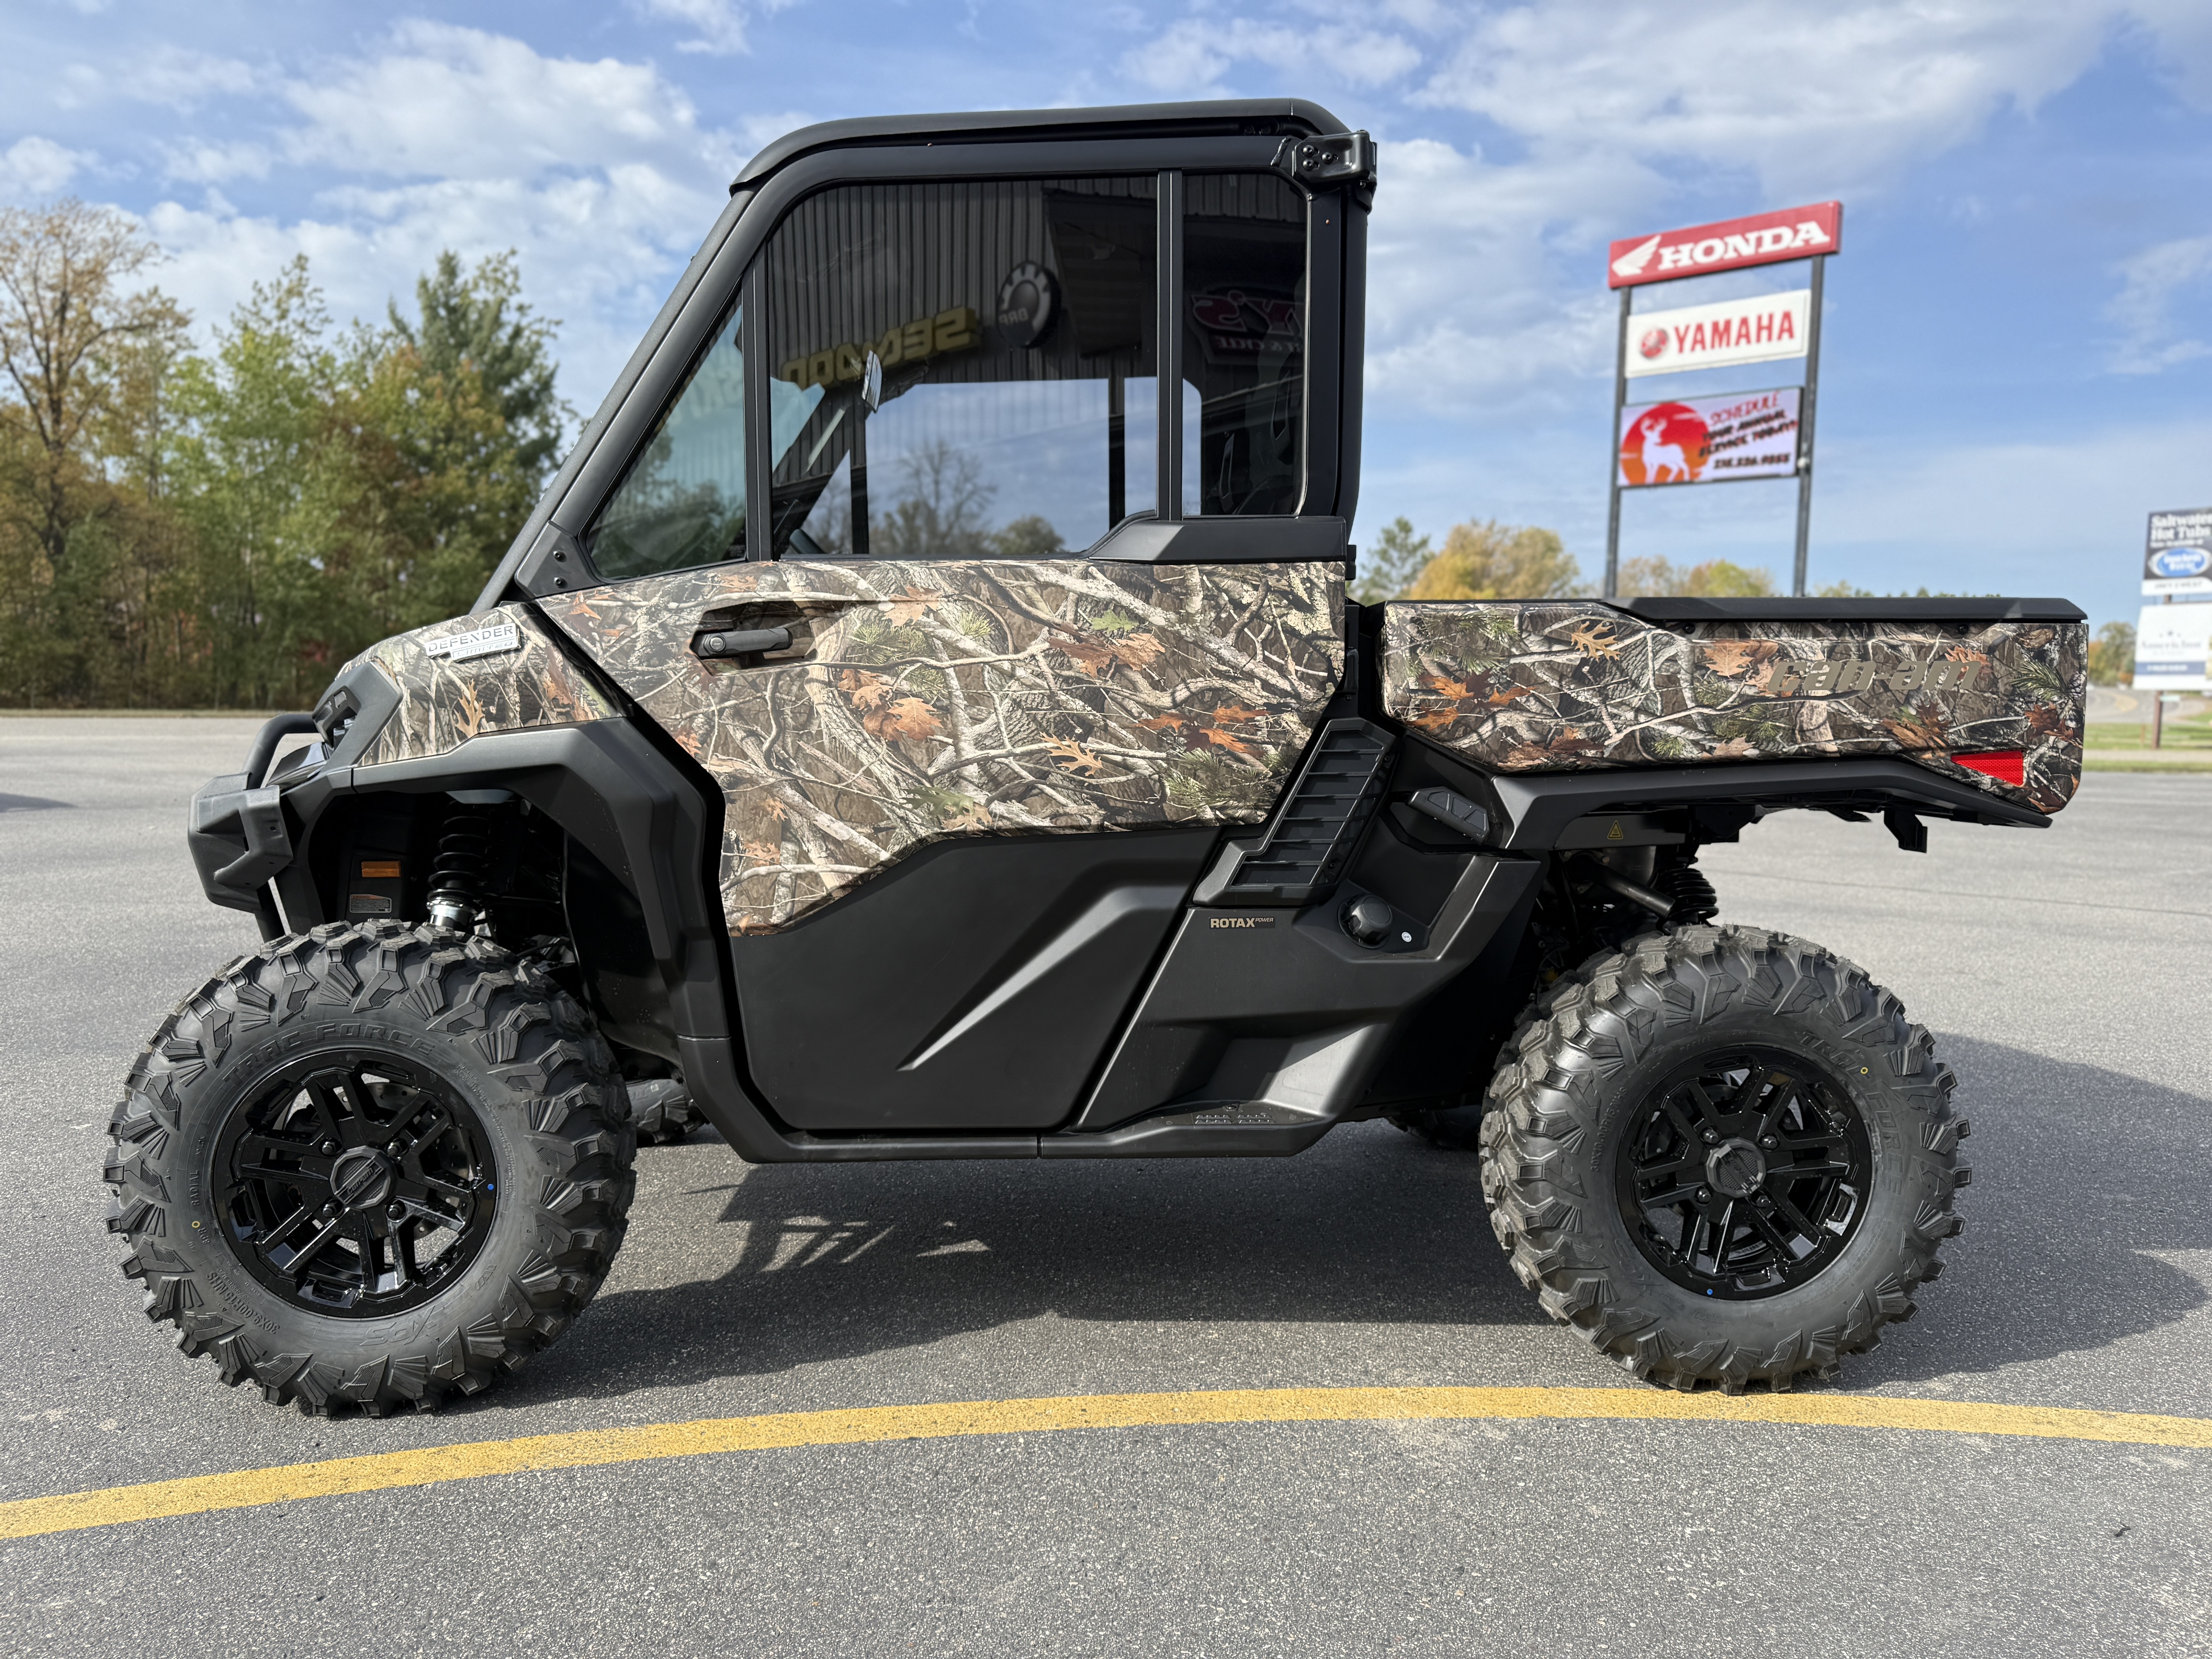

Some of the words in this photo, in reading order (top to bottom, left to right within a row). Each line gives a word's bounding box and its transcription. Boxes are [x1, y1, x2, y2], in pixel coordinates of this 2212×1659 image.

[1657, 220, 1831, 270] HONDA
[1674, 311, 1794, 354] YAMAHA
[429, 626, 513, 652] DEFENDER
[1211, 918, 1255, 928] ROTAX
[222, 1030, 303, 1087] TRAC
[316, 1022, 436, 1057] FORCE
[1866, 1091, 1902, 1194] FORCE
[189, 1169, 200, 1206] RADIAL
[203, 1269, 228, 1296] NHS
[221, 1289, 282, 1337] 30X9.00R15
